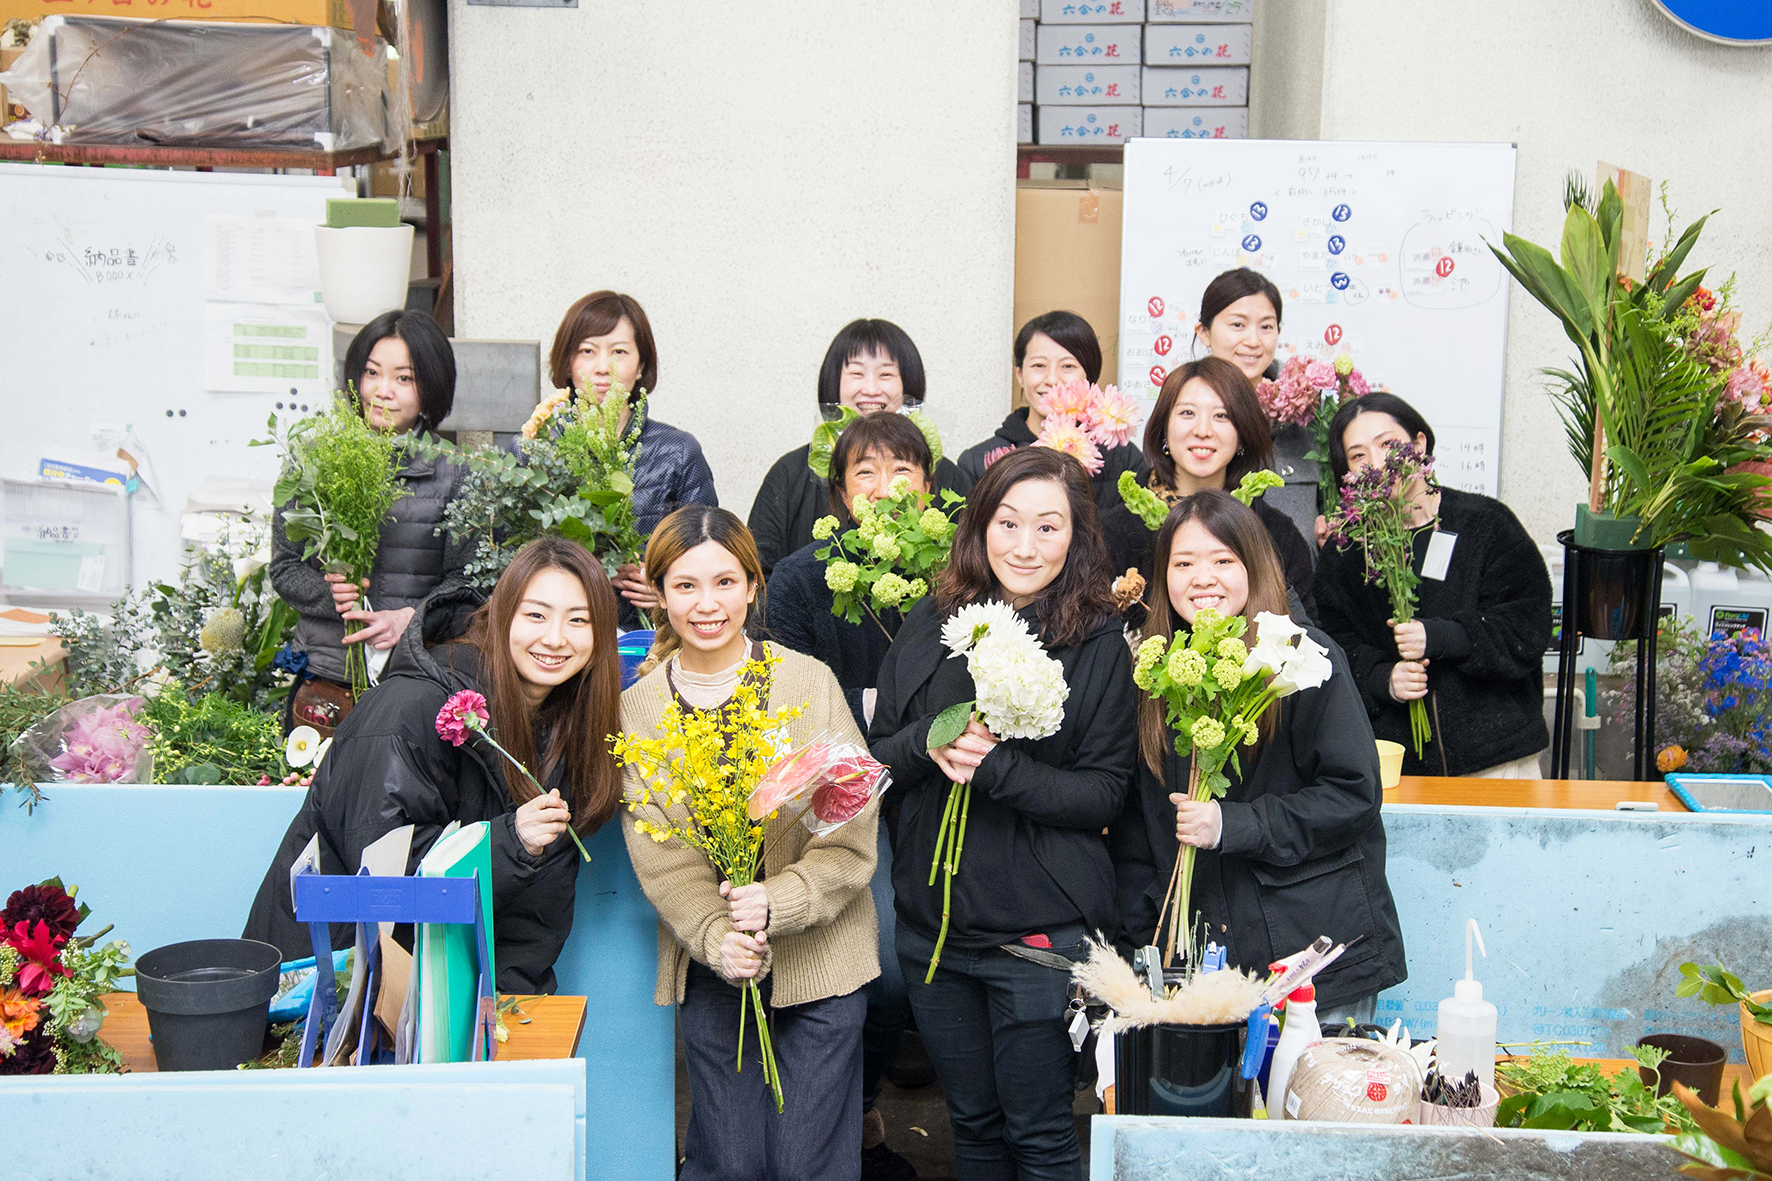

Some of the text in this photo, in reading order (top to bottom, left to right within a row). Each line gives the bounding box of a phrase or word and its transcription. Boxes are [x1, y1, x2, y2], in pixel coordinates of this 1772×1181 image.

[1058, 43, 1120, 57] 六合の花
[1168, 43, 1232, 58] 六合の花
[1058, 83, 1121, 97] 六合の花
[1164, 85, 1227, 99] 六合の花
[1060, 123, 1122, 137] 六合の花
[84, 246, 140, 267] 納品書
